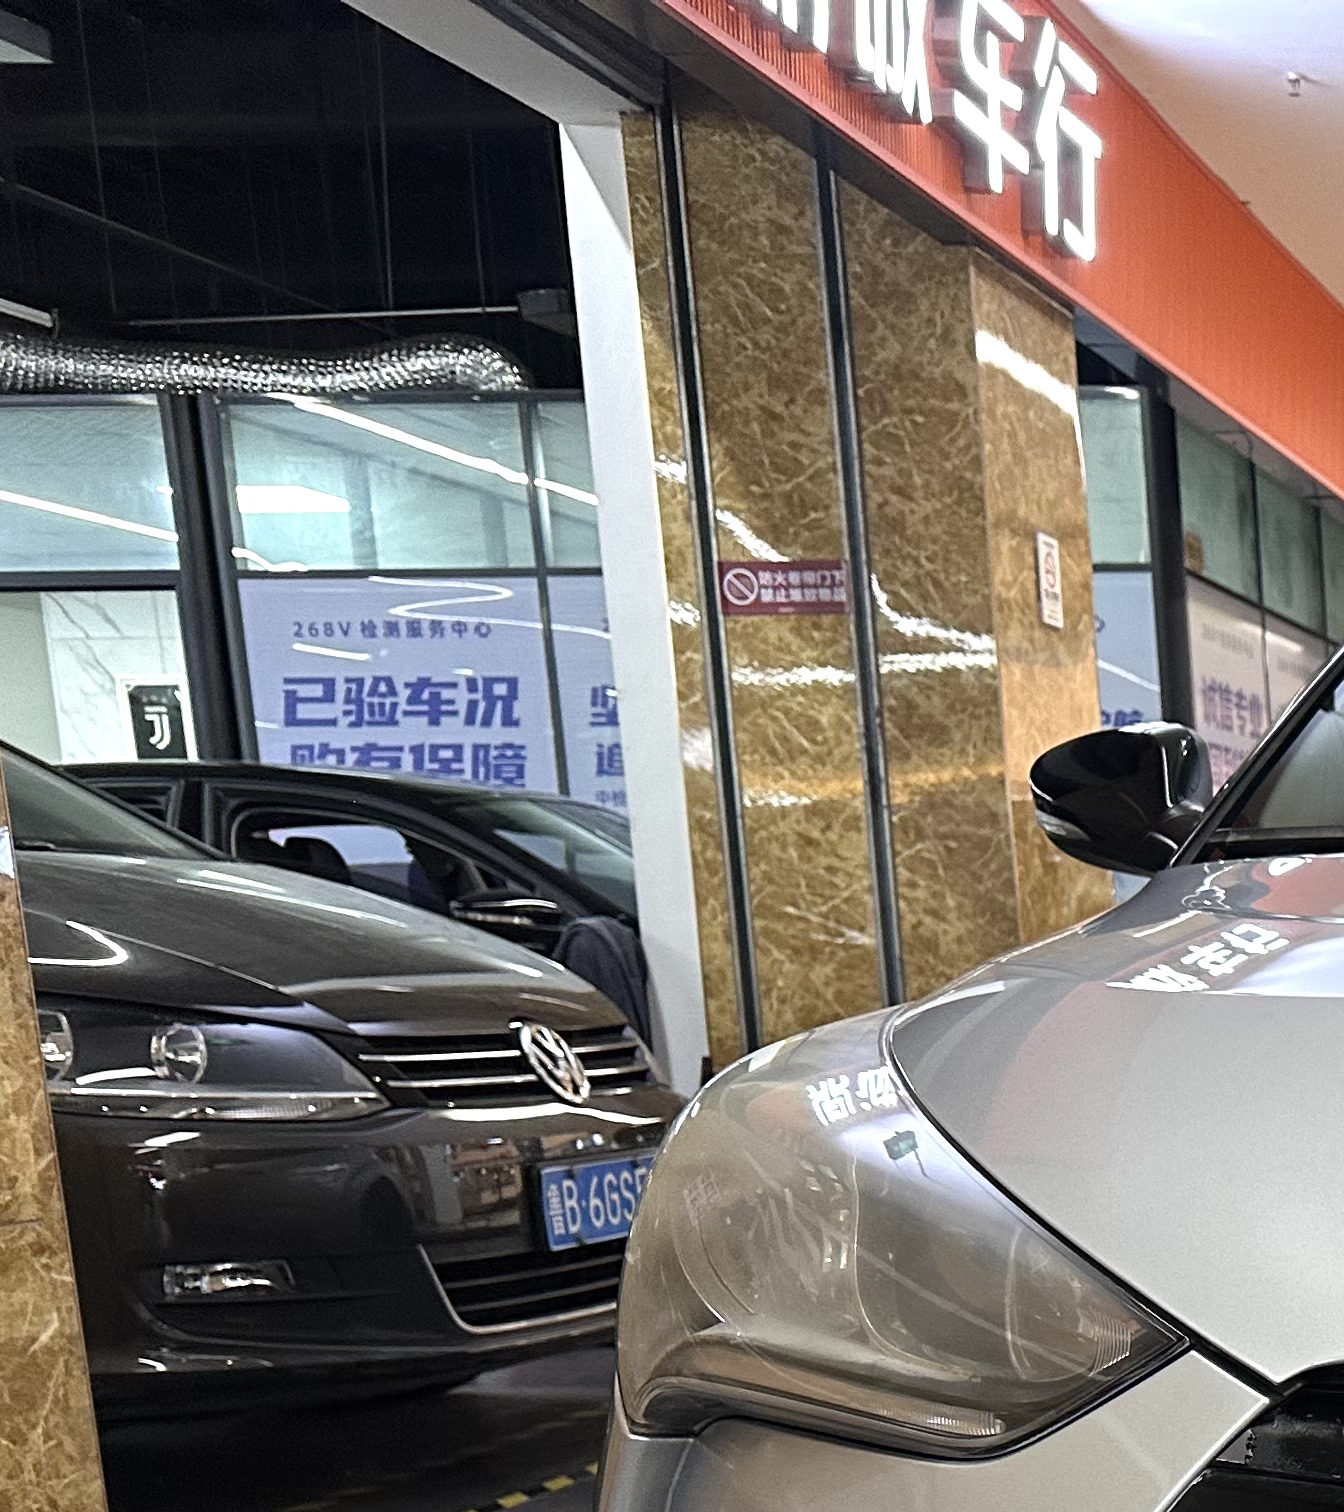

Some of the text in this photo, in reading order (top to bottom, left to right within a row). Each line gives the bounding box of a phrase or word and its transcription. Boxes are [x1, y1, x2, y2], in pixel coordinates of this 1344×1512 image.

[760, 0, 1103, 261] 车行
[293, 618, 492, 640] 268V 检测服务中心
[283, 675, 521, 729] 已验车况
